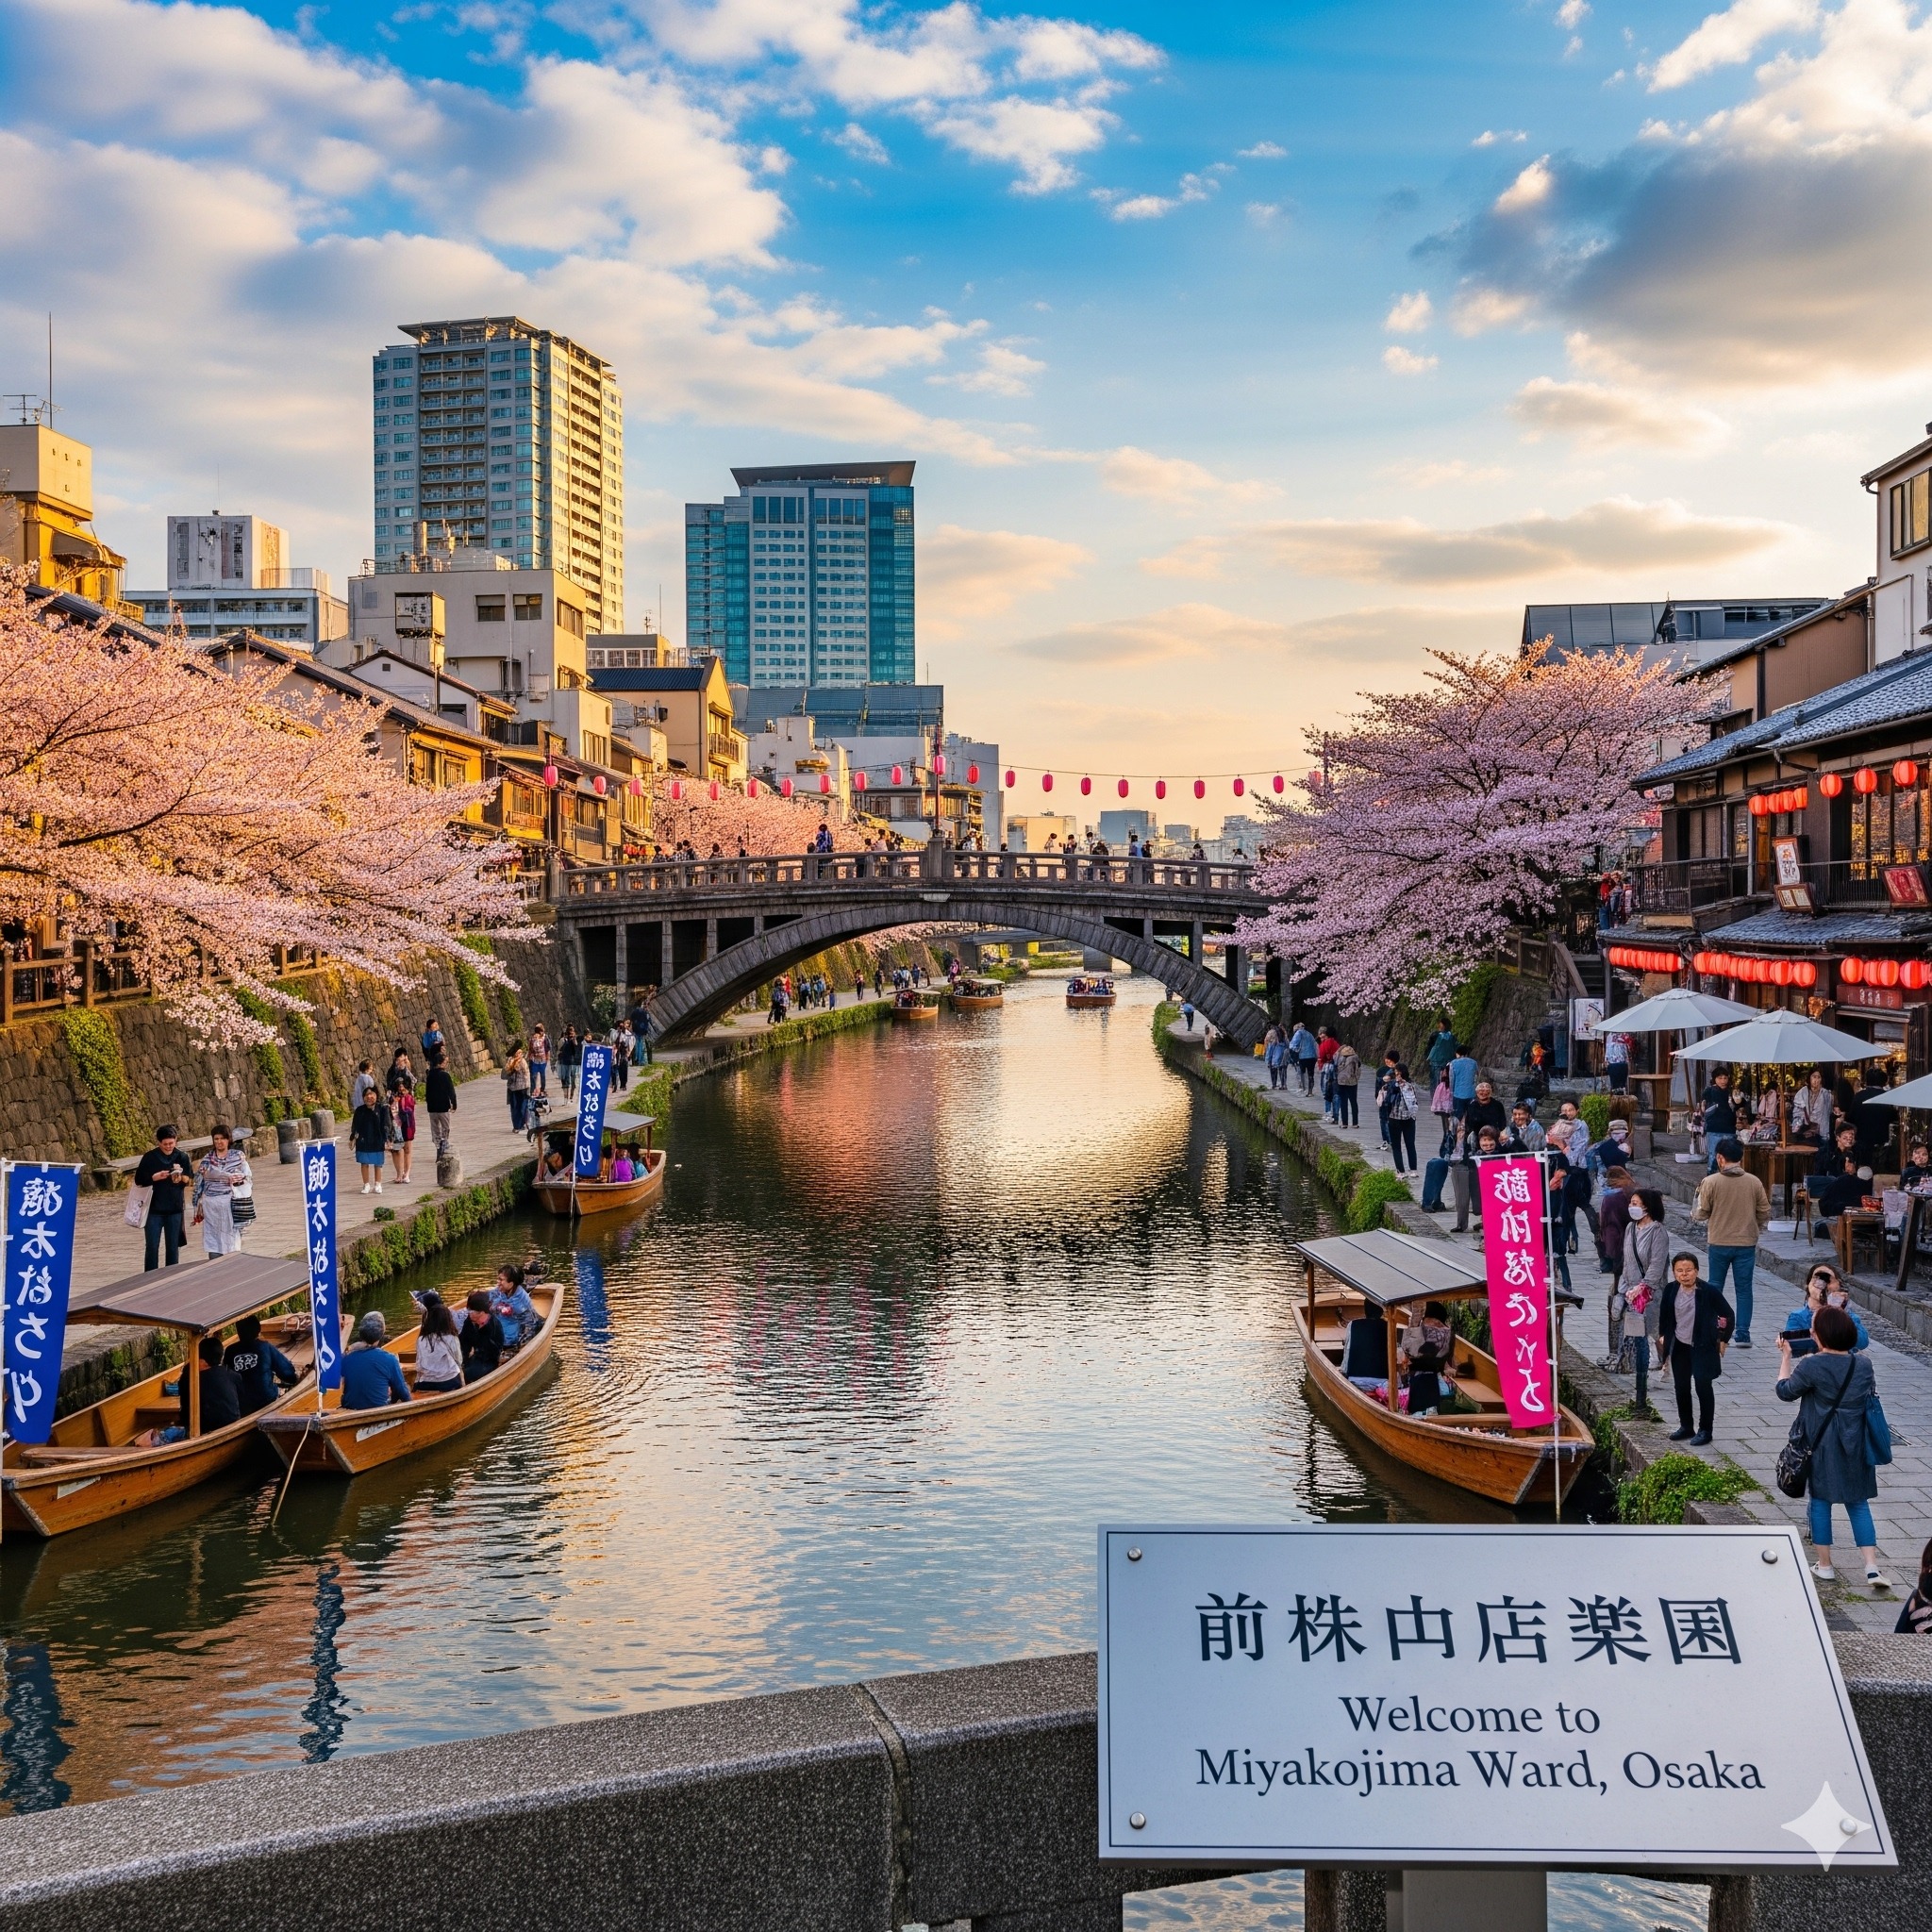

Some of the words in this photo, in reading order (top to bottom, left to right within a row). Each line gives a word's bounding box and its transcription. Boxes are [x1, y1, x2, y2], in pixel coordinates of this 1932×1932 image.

[1338, 1695, 1543, 1733] Welcome
[1555, 1702, 1601, 1734] to
[1195, 1747, 1461, 1797] Miyakojima
[1466, 1749, 1607, 1796] Ward,
[1623, 1750, 1766, 1790] Osaka
